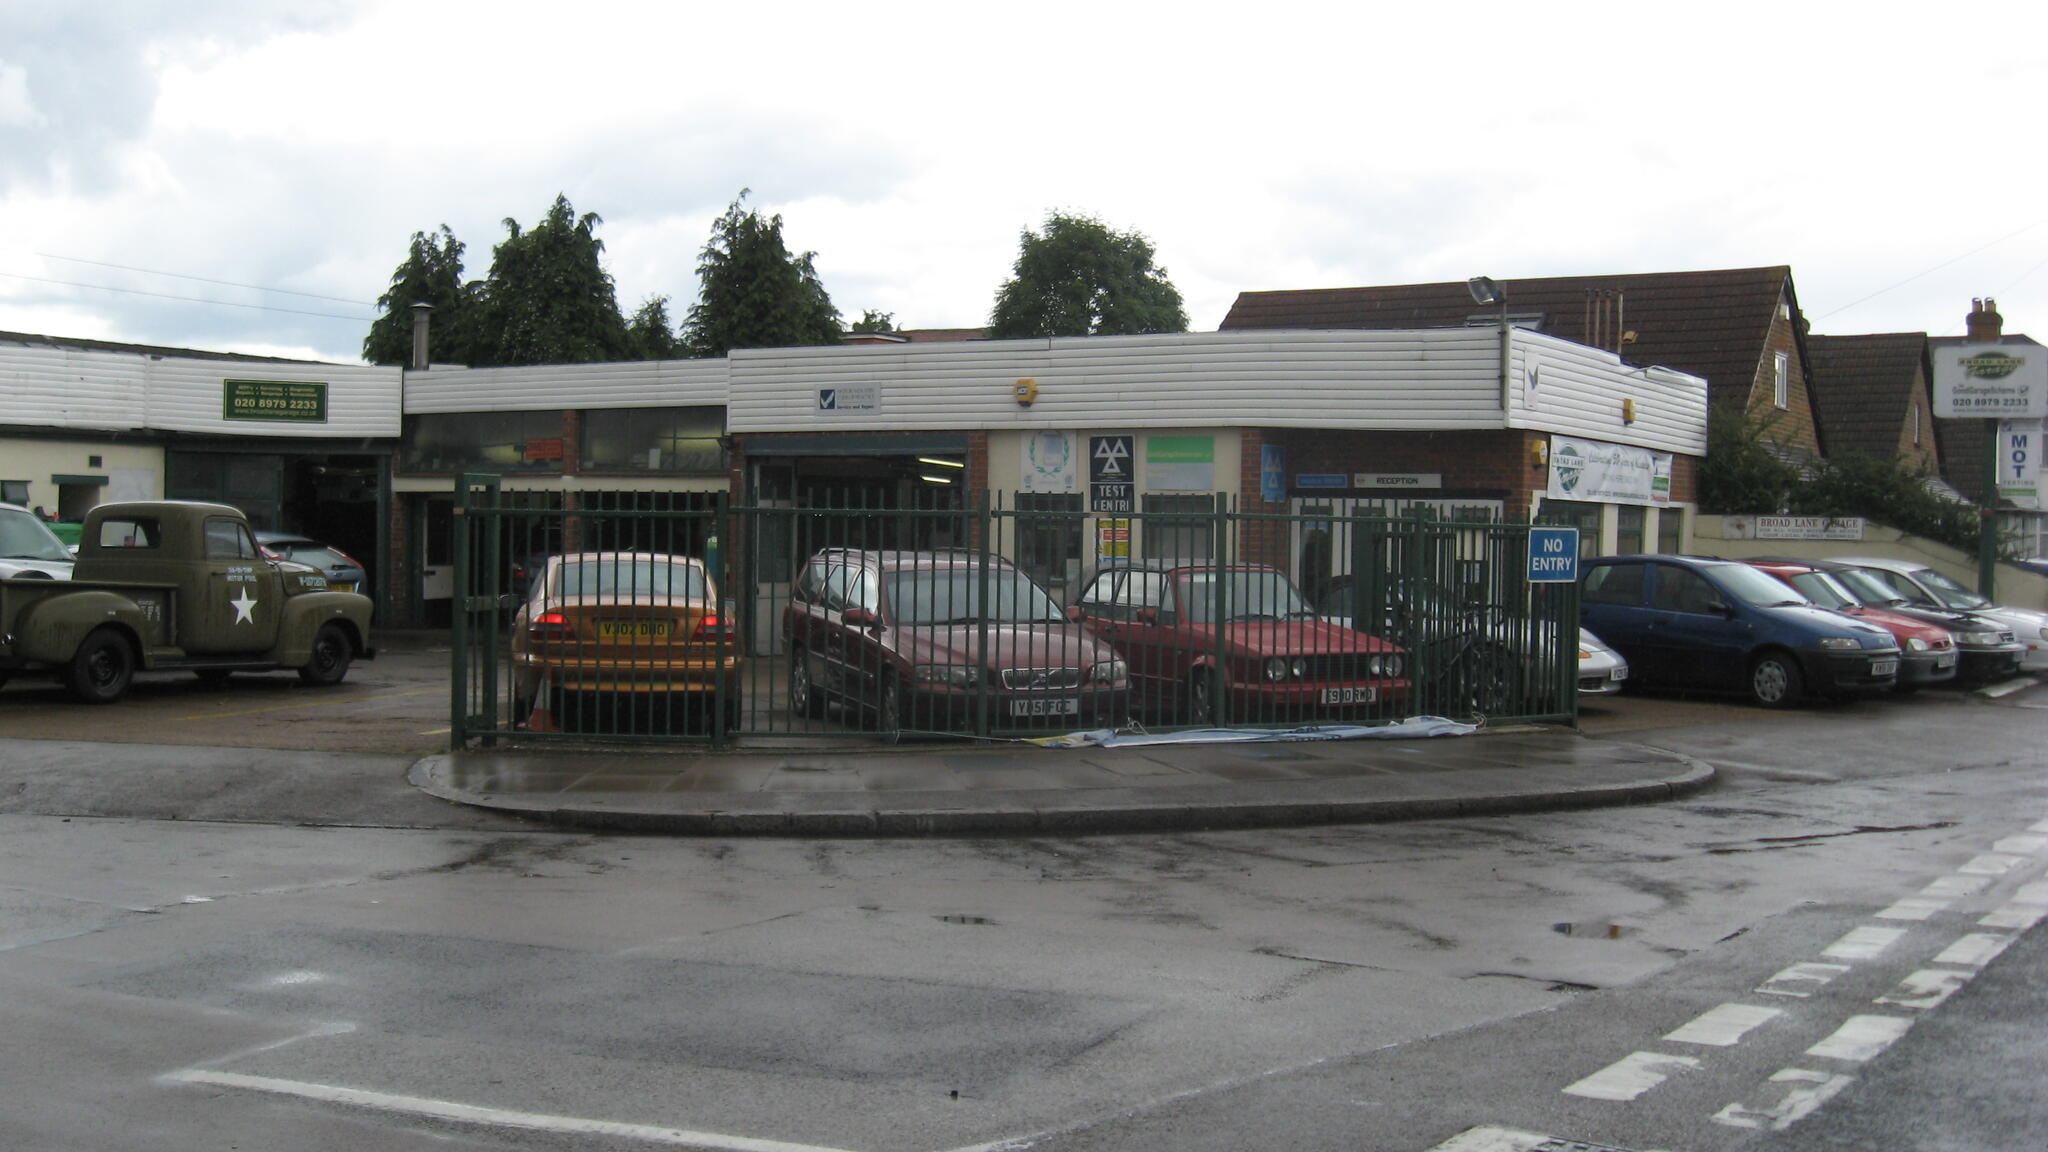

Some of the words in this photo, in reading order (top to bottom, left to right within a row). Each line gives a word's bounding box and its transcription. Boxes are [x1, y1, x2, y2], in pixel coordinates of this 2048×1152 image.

[234, 399, 255, 408] 020
[259, 400, 286, 409] 8979
[290, 401, 317, 410] 2233
[2011, 434, 2027, 478] MOT
[1377, 477, 1418, 485] RECEPTION
[1099, 485, 1126, 497] TEST
[1760, 519, 1790, 527] BROAD
[1795, 519, 1817, 527] LANE
[1543, 538, 1563, 552] NO
[1532, 557, 1572, 570] ENTRY
